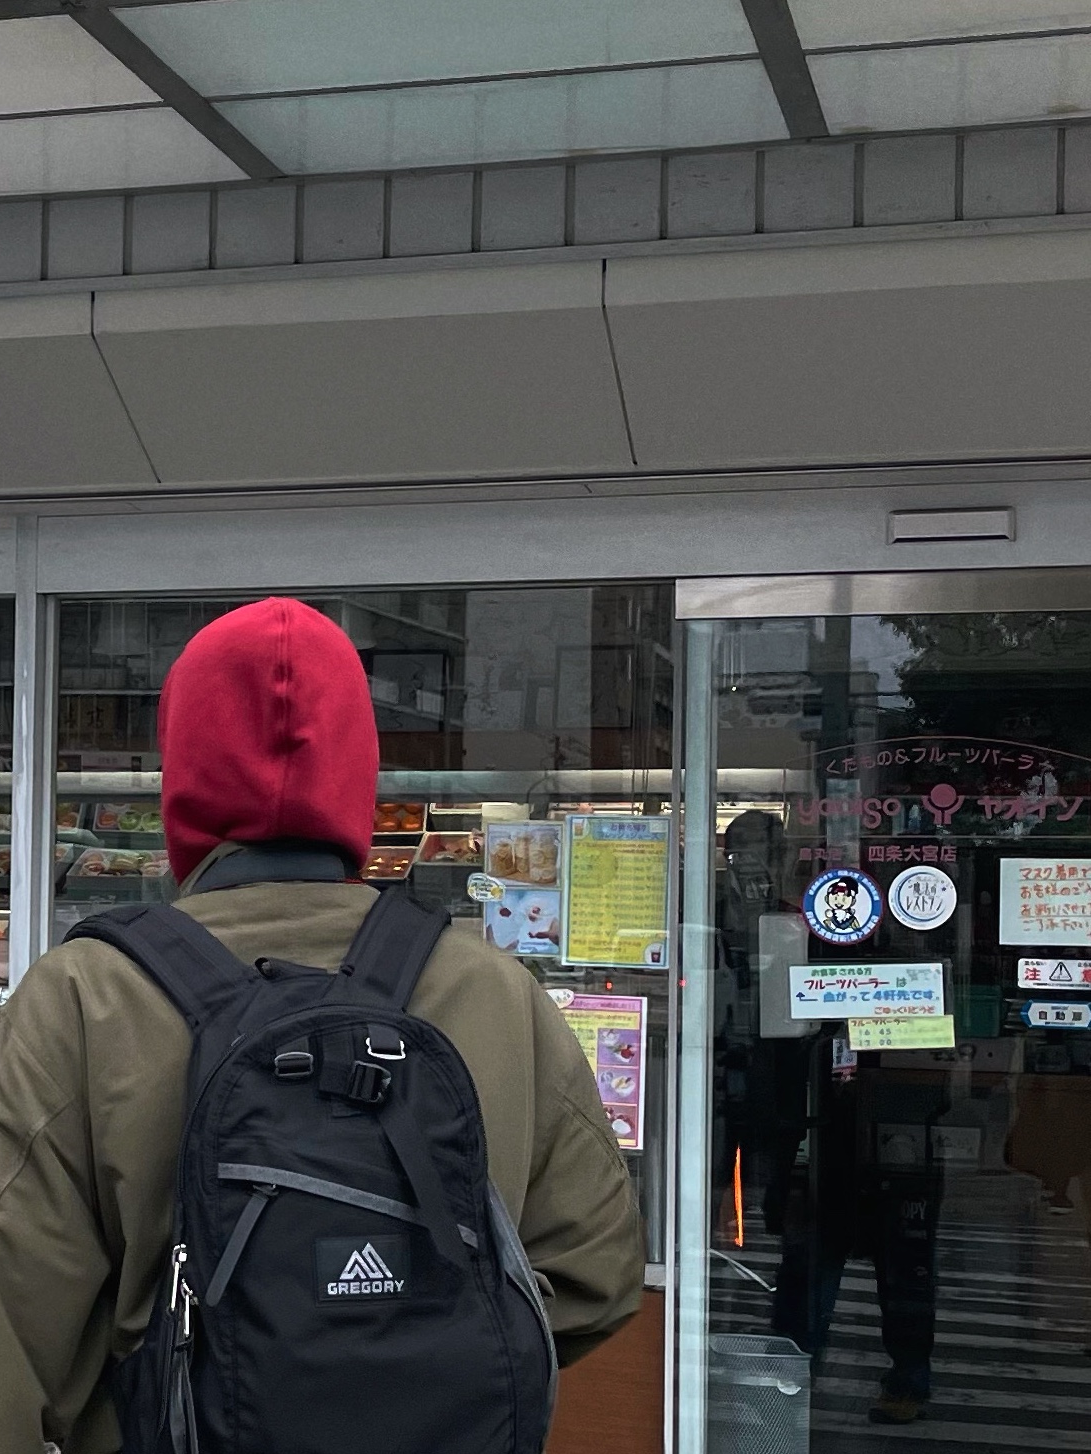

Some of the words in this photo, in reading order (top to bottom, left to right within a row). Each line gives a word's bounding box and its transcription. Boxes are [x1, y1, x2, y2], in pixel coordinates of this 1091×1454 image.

[868, 845, 958, 863] 四条大宮店
[1024, 967, 1041, 981] 注
[327, 1280, 405, 1295] GREGORY
